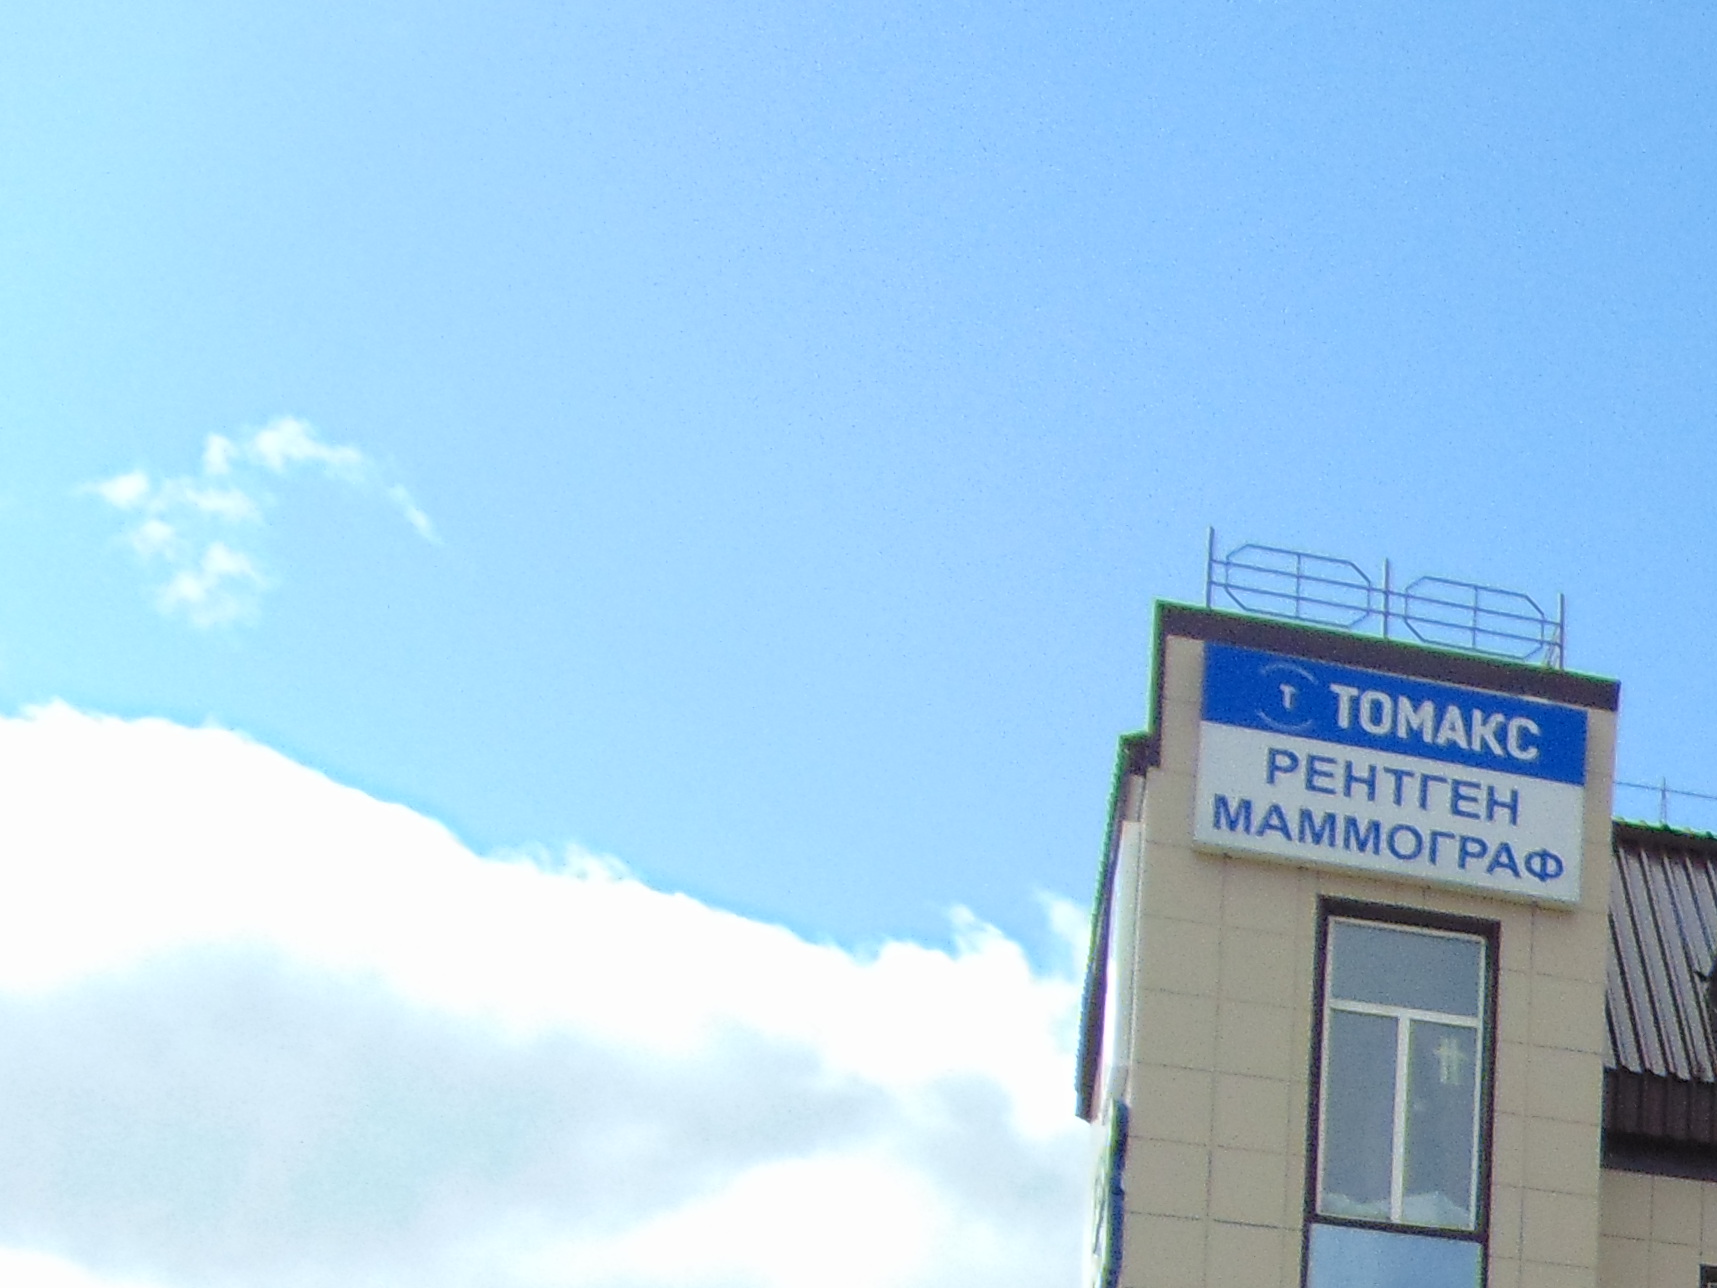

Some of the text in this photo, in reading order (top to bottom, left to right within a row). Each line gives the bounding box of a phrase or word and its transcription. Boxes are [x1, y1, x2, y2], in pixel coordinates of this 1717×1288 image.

[1329, 682, 1541, 761] ТОМАКС
[1266, 747, 1520, 827] РЕНТГЕН
[1212, 794, 1564, 882] МАММОГРАФ
